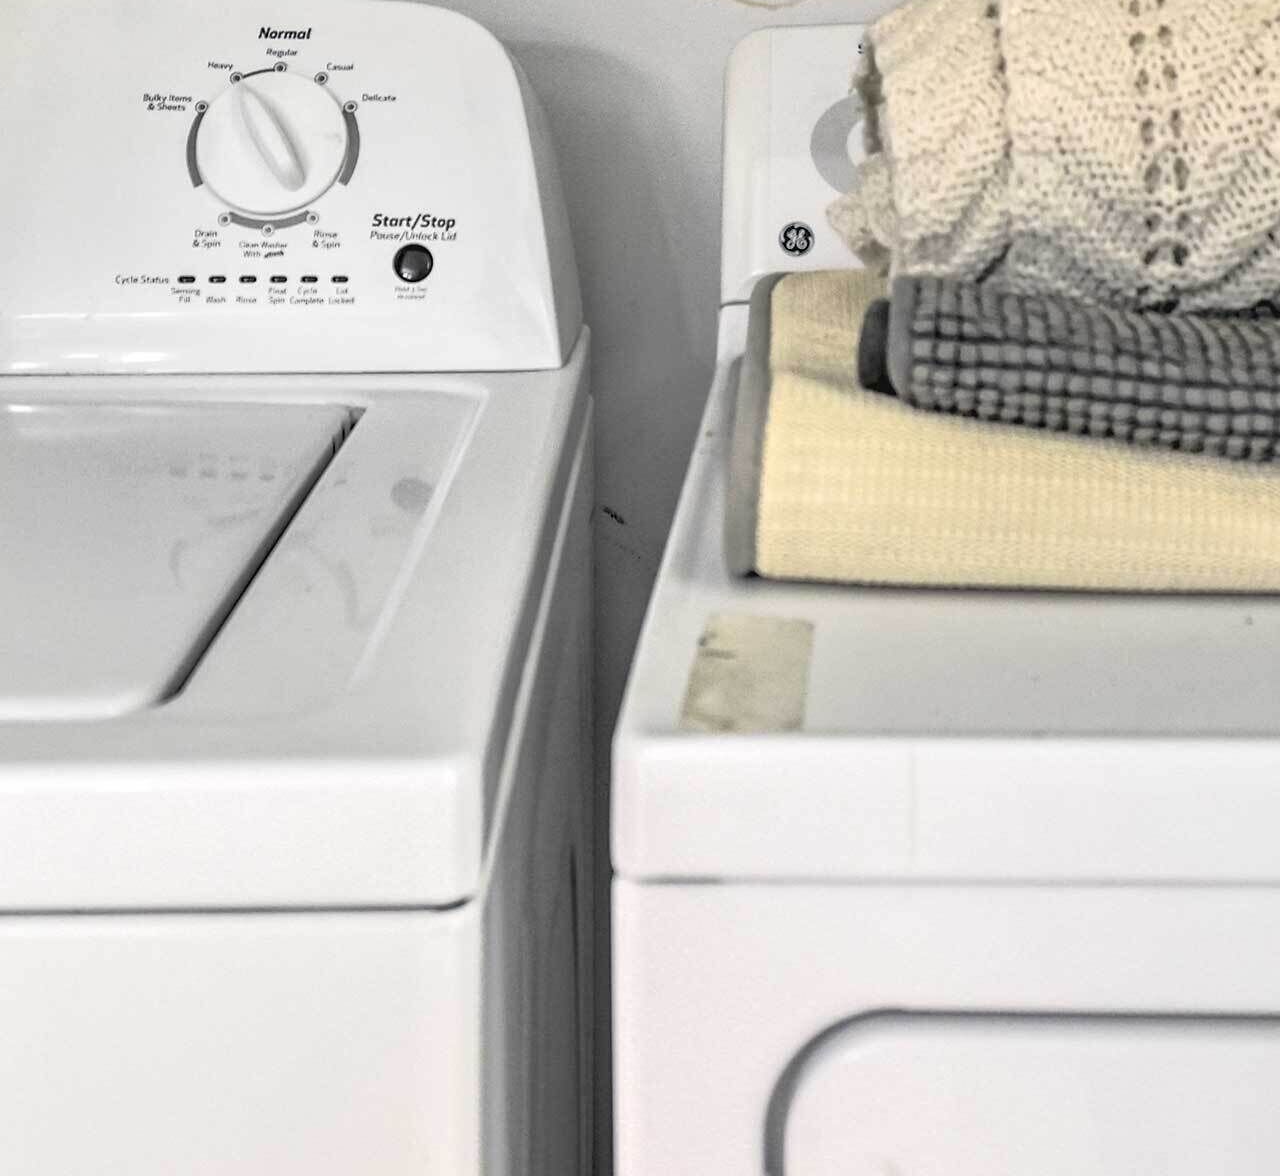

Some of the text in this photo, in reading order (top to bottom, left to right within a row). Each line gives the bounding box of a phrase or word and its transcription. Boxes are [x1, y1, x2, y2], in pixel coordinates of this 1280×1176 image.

[258, 27, 312, 40] Normal
[266, 48, 298, 57] Regular
[208, 61, 233, 71] Heavy
[326, 62, 354, 71] Casual
[143, 94, 192, 103] Bulky Items
[362, 94, 396, 102] Delicate
[147, 103, 186, 112] & Sheets
[371, 213, 456, 232] Start/Stop
[194, 230, 218, 238] Drain
[313, 230, 338, 238] Rinse
[370, 230, 457, 242] Pause/Unlock Lid
[192, 239, 221, 249] & Spin
[321, 240, 341, 249] Spin
[115, 275, 170, 285] Cycle Status
